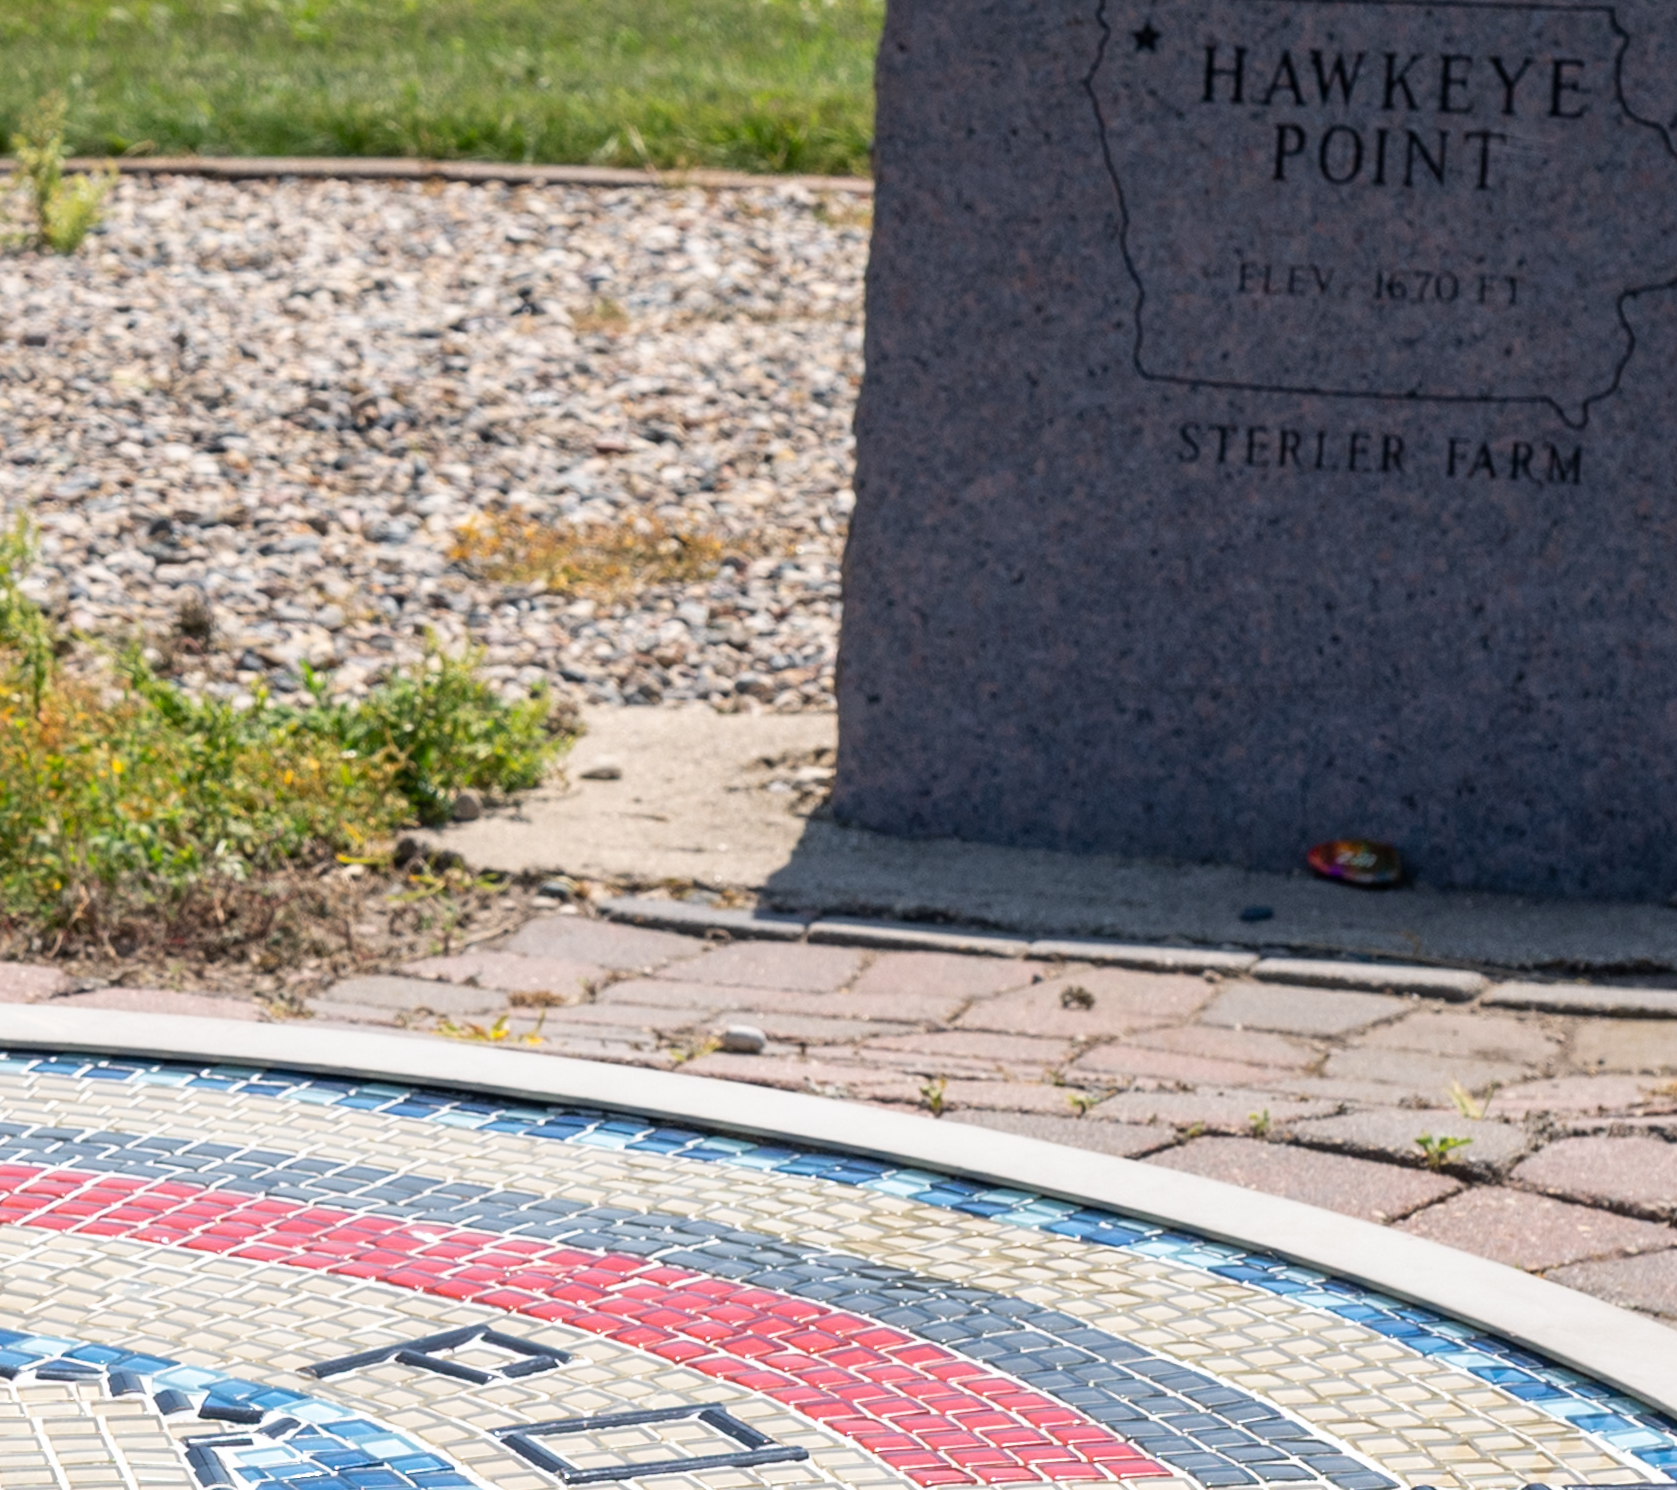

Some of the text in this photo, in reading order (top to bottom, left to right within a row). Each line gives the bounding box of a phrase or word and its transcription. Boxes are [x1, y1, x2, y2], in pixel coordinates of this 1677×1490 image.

[1201, 44, 1589, 119] HAWKEYE
[1270, 122, 1508, 191] POINT
[1372, 267, 1460, 305] 1670
[1477, 272, 1524, 306] FT
[1176, 421, 1585, 487] STERLER FARM
